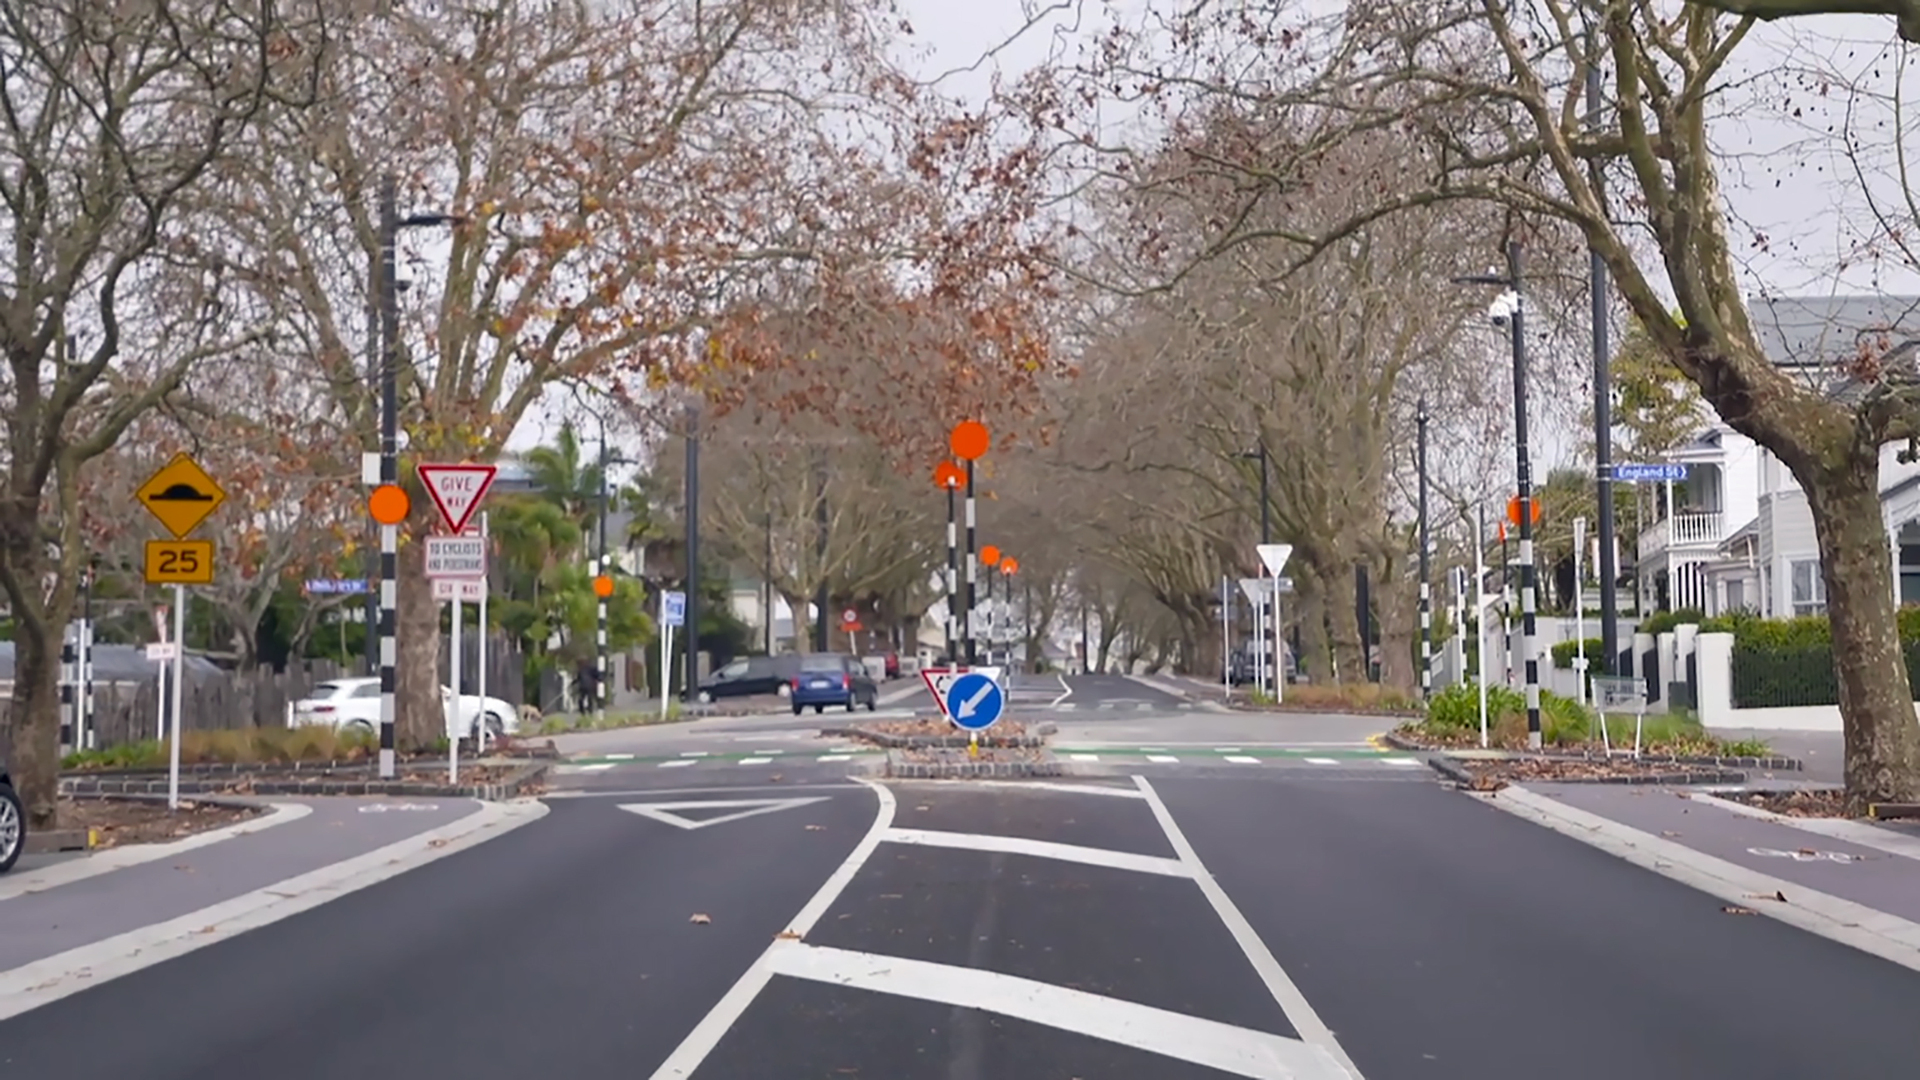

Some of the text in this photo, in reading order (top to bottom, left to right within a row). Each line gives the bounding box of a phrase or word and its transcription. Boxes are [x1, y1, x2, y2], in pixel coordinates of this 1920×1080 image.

[1618, 466, 1679, 480] England St
[441, 476, 472, 491] GIVE
[447, 497, 466, 507] WAY
[430, 543, 481, 555] TO CYCLISTS
[159, 550, 198, 573] 25
